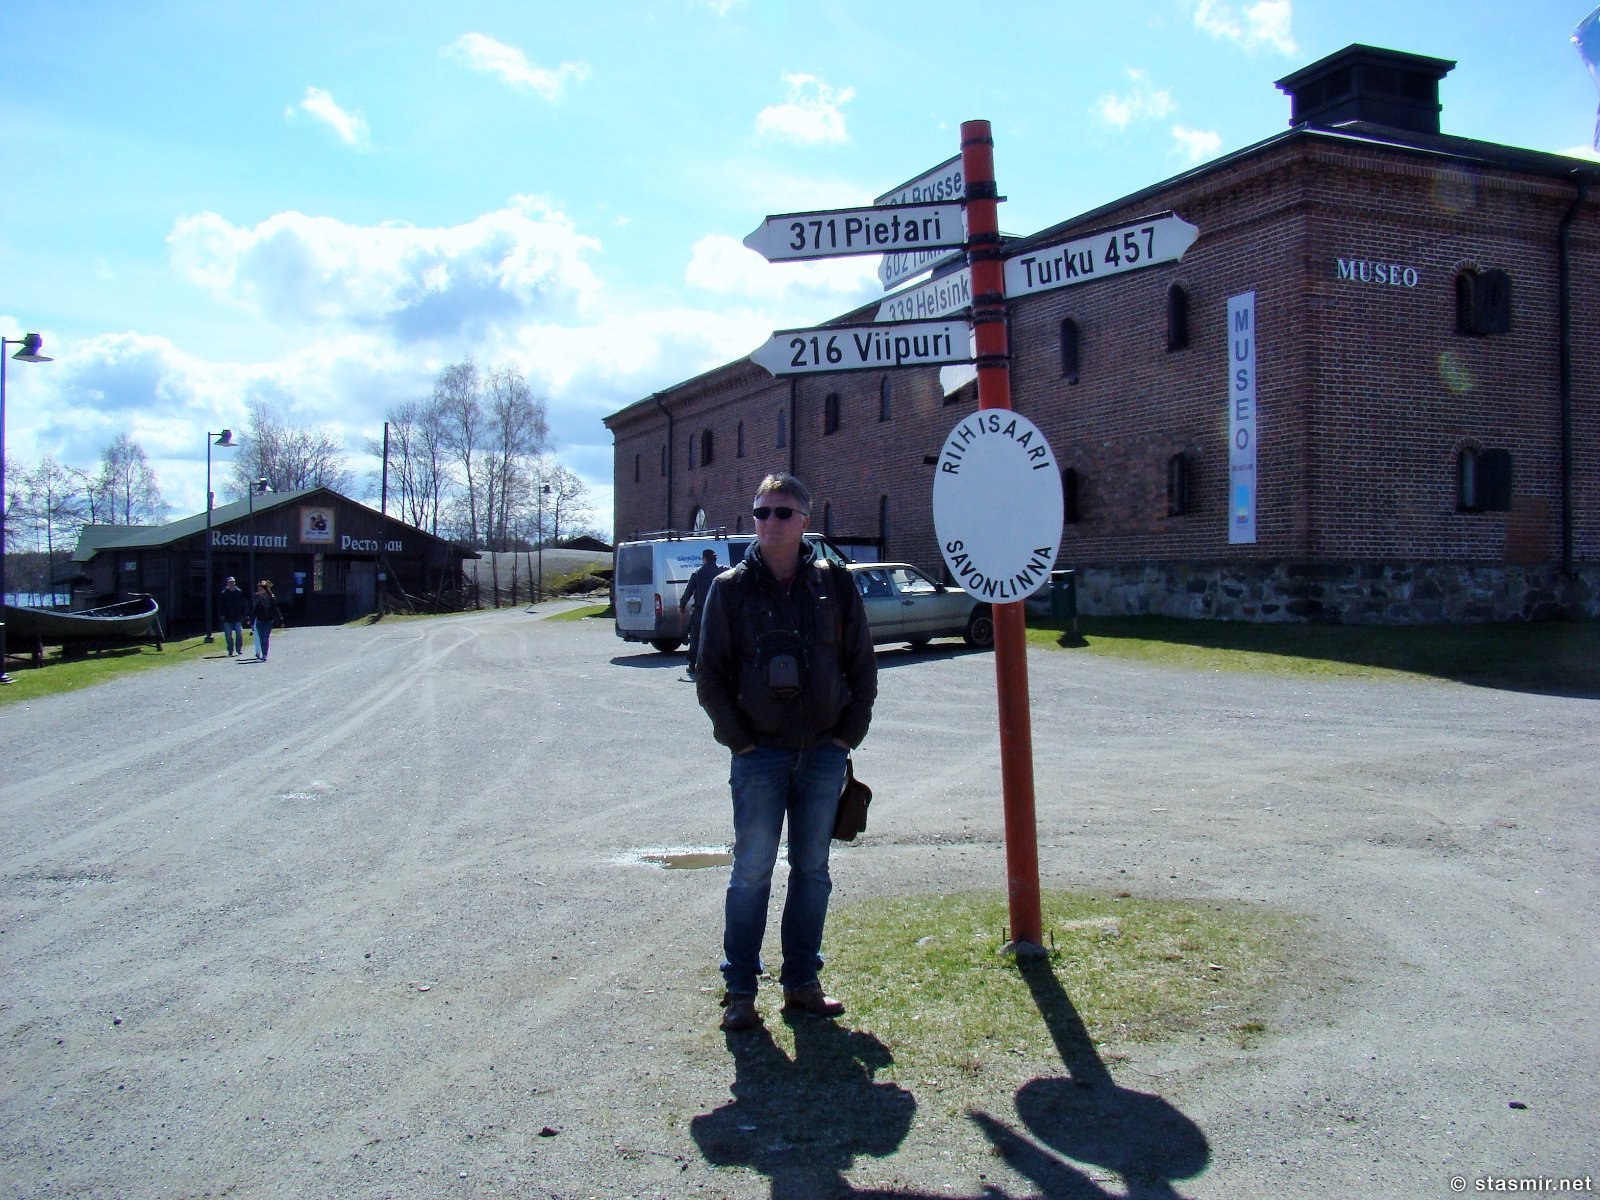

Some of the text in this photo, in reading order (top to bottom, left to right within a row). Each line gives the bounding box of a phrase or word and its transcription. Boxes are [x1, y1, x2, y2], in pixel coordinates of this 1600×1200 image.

[912, 171, 962, 203] Brysse
[789, 211, 941, 251] 371 Pietari
[885, 252, 909, 280] 602
[1020, 226, 1154, 288] Turku 457
[1336, 258, 1418, 288] MUSEO
[889, 274, 970, 321] 339 Helsink
[789, 327, 951, 367] 216 Viipuri
[1234, 308, 1249, 451] MUSEO
[942, 414, 1050, 475] RIIHISAARI
[946, 540, 1052, 598] SAVONLINNA
